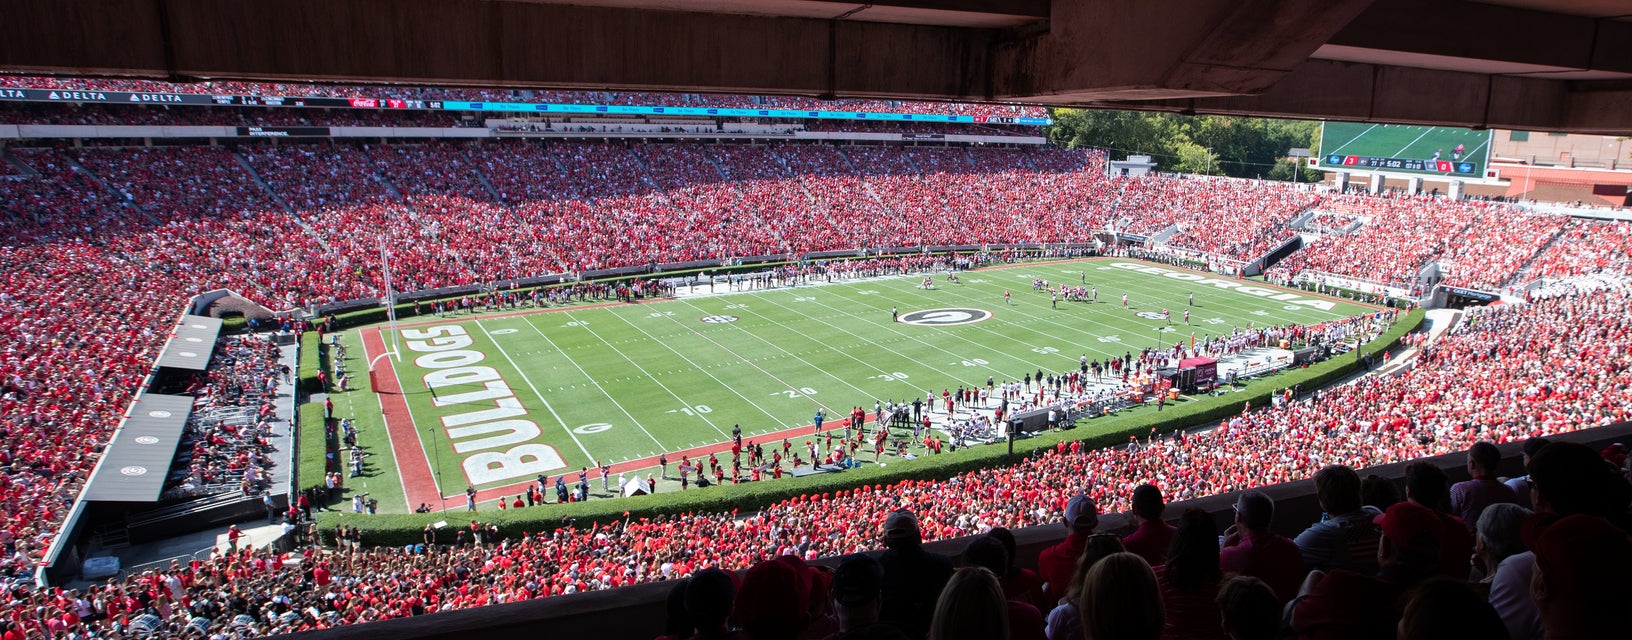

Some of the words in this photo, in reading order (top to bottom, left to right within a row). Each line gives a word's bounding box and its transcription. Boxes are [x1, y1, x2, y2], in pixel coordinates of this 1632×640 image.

[62, 92, 106, 100] DELTA
[143, 94, 182, 102] DELTA
[1386, 160, 1401, 168] 5:02
[1109, 263, 1336, 310] GEORGIA
[962, 358, 989, 368] 40
[878, 372, 909, 383] 30
[783, 387, 818, 399] 20
[401, 325, 568, 486] BULLDOGS
[680, 404, 713, 416] 10
